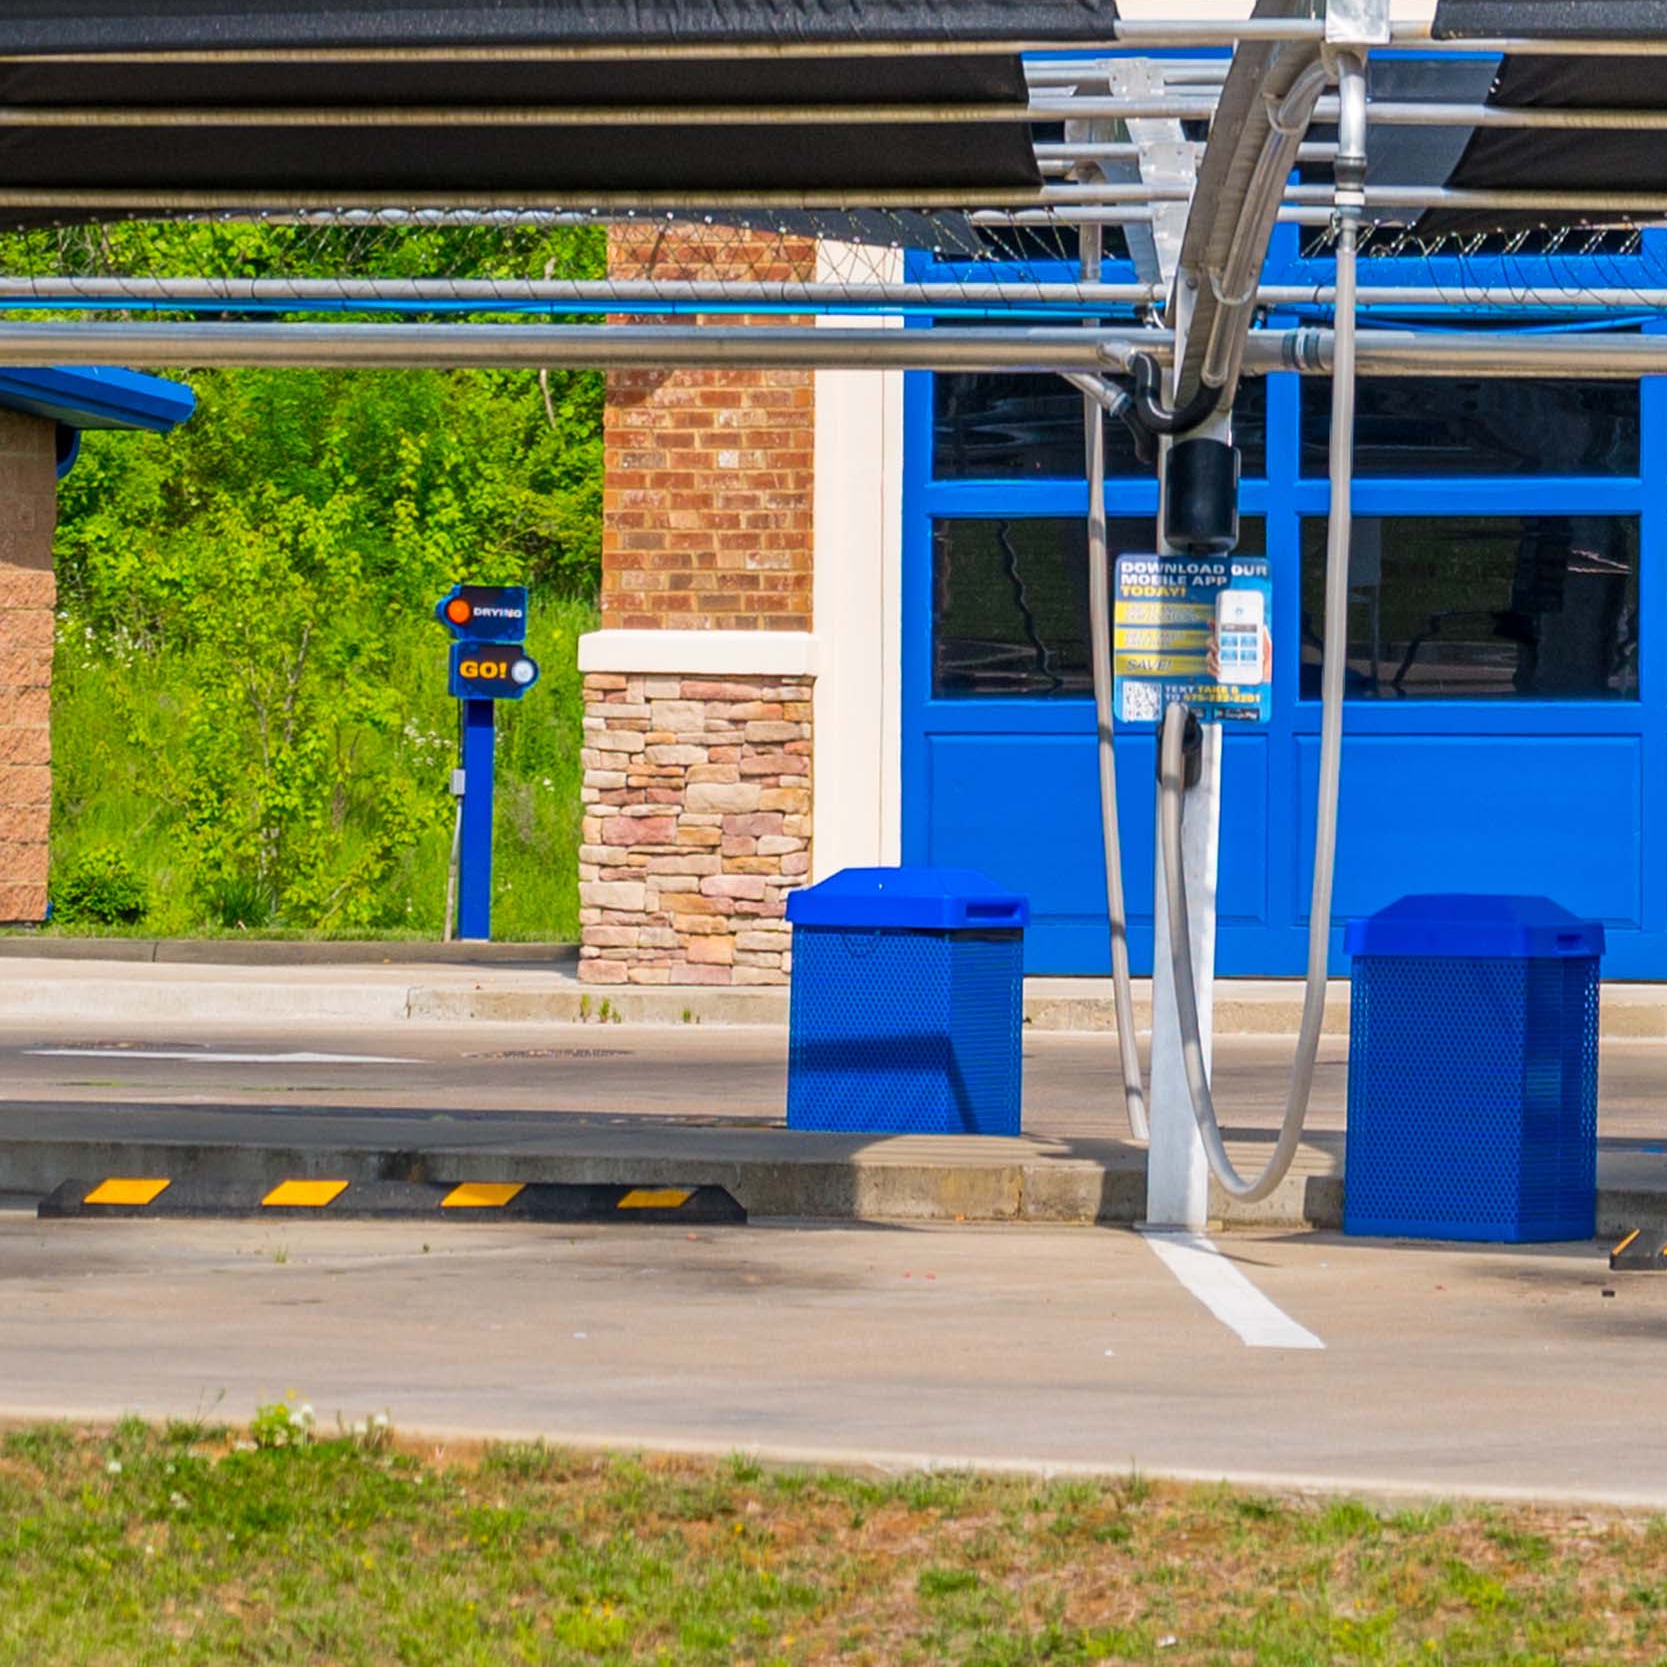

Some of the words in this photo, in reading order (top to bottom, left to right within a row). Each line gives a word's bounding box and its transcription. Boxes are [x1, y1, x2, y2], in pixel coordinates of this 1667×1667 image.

[1120, 562, 1225, 575] DOWNLOAD
[1231, 564, 1268, 576] OUR
[1120, 574, 1188, 586] MOBILE
[1192, 575, 1228, 586] APP
[1121, 586, 1187, 597] TODAY!
[473, 607, 523, 618] DRYING
[459, 660, 508, 679] GO!
[1128, 659, 1174, 671] SAVE!
[1165, 685, 1194, 693] TEXT
